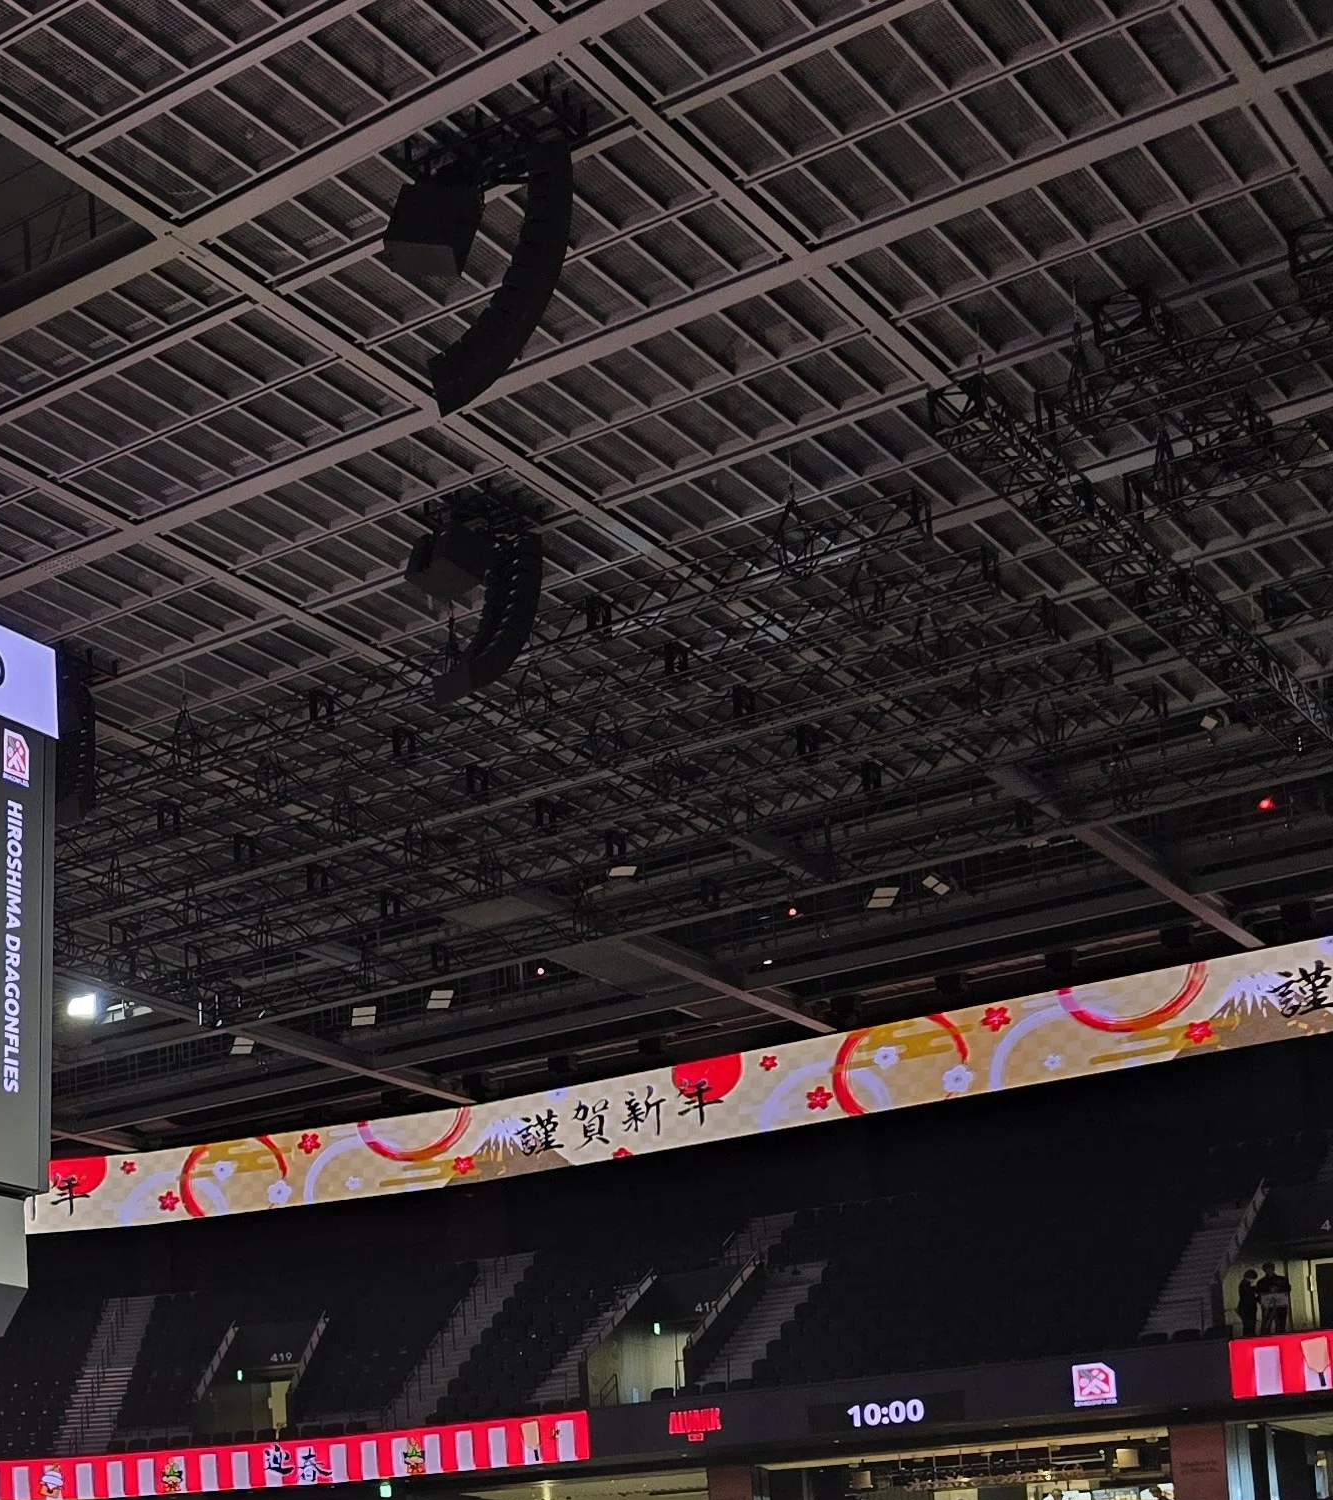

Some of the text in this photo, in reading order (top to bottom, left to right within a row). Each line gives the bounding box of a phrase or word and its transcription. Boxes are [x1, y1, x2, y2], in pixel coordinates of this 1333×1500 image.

[2, 799, 23, 1093] HIROSHIMA DRAGONFLIES
[515, 1079, 723, 1157] 謹賀新年
[270, 1351, 293, 1363] 419
[847, 1398, 926, 1428] 10:00
[262, 1444, 332, 1486] 迎春
